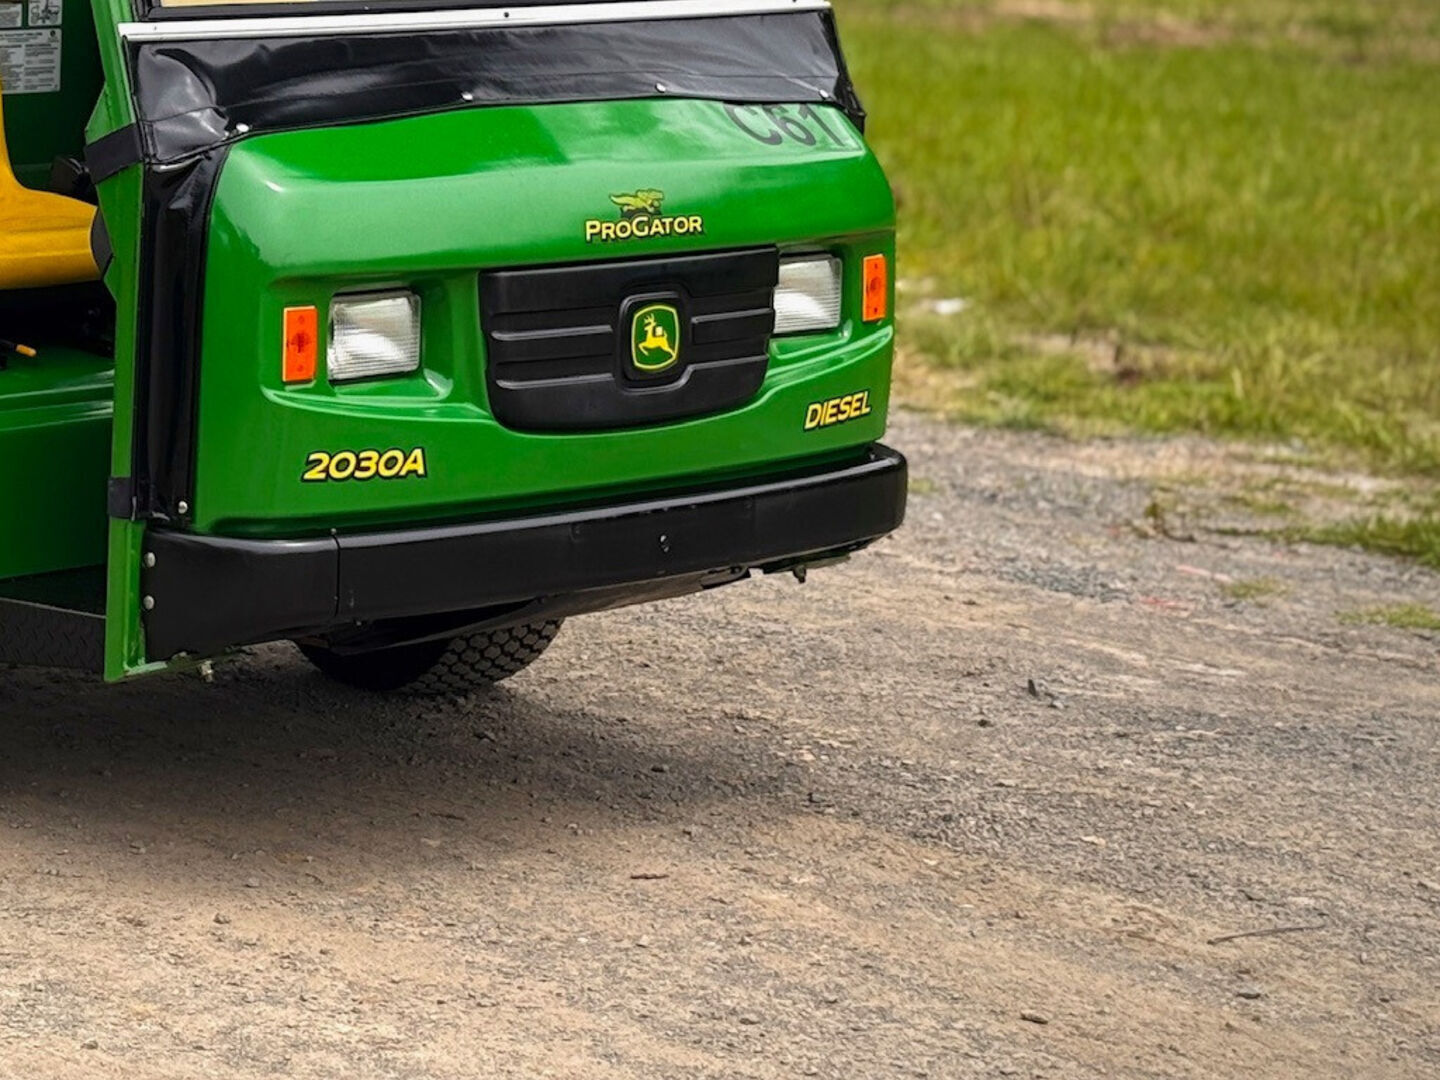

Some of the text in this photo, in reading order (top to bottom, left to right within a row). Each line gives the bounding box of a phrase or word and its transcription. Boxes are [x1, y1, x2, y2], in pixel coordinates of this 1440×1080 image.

[722, 103, 845, 146] C61
[803, 390, 872, 431] DIESEL
[302, 447, 426, 480] 2030A
